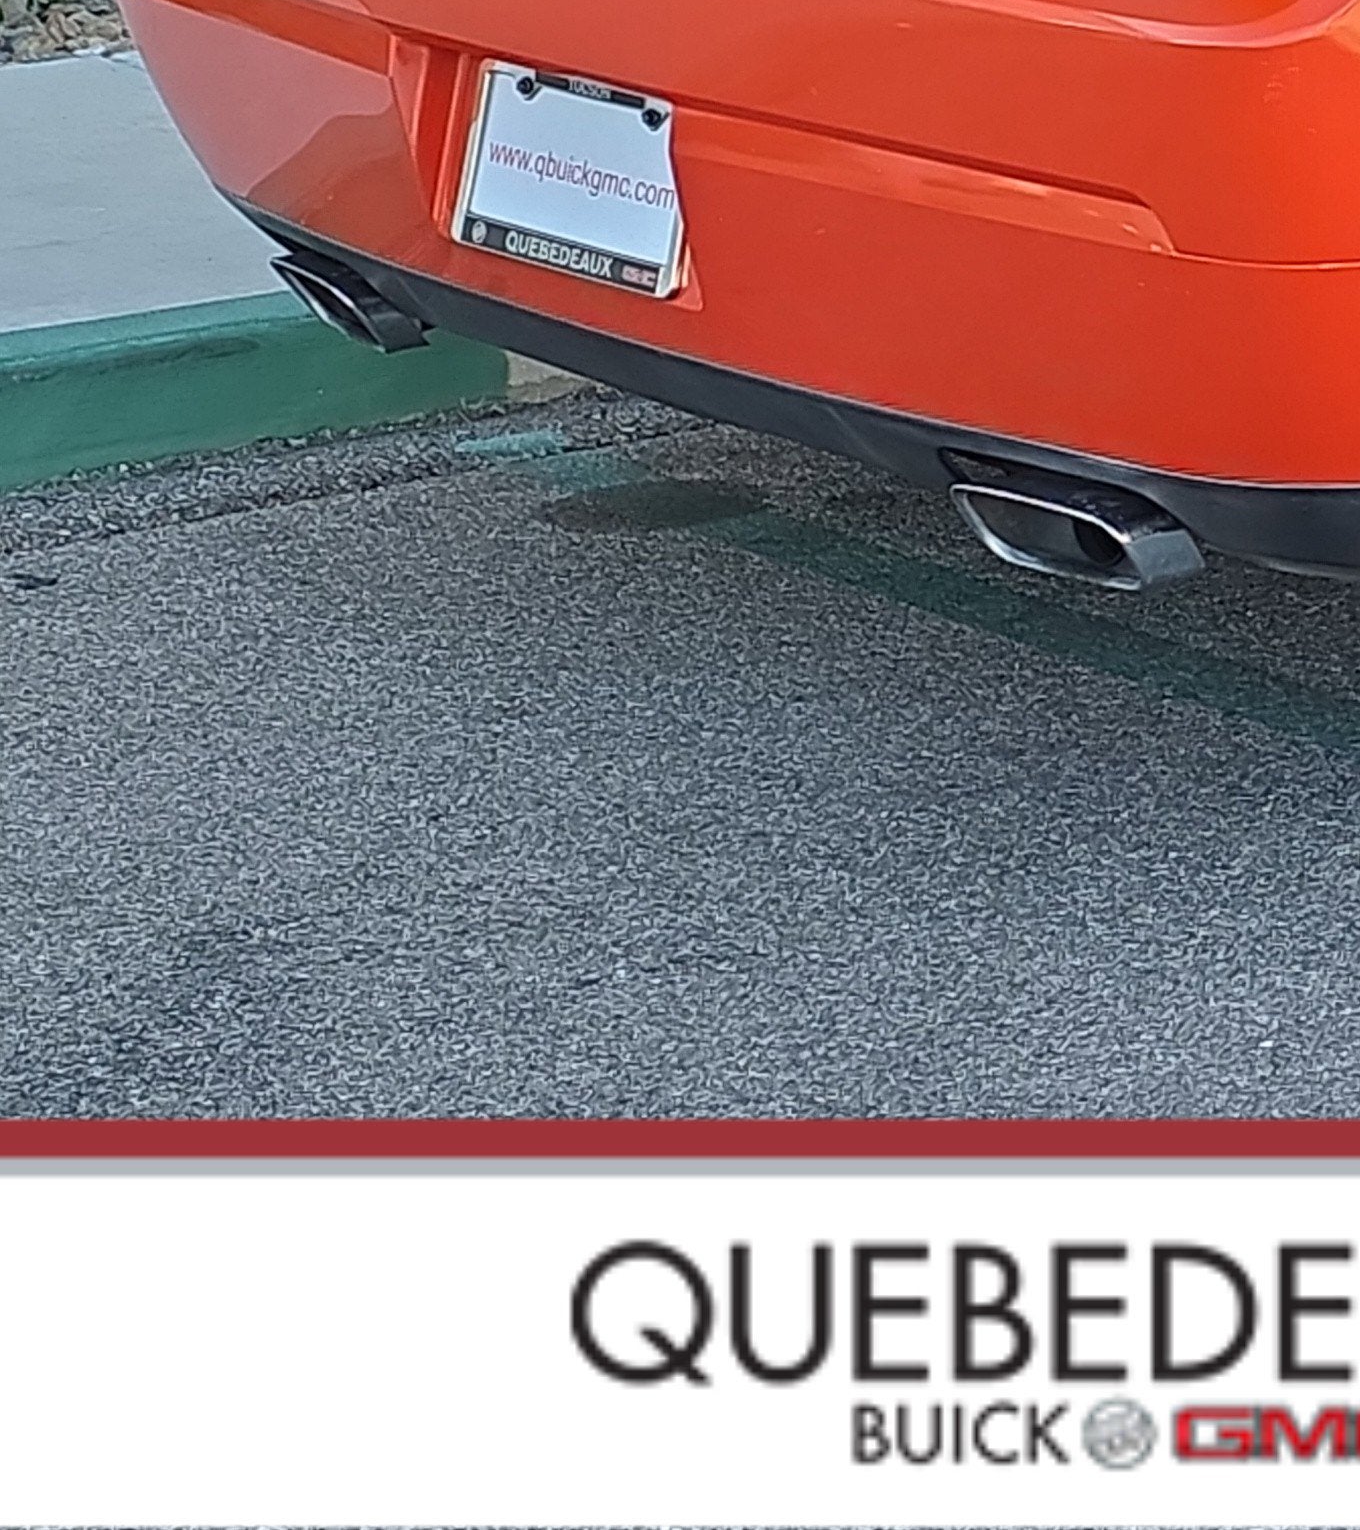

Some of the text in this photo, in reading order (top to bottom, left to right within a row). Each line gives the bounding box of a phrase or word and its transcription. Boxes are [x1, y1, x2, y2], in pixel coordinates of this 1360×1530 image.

[568, 77, 612, 101] TUCSON
[489, 141, 676, 211] www.qbuickgmc.com
[504, 229, 614, 279] QUEBEDEAUX
